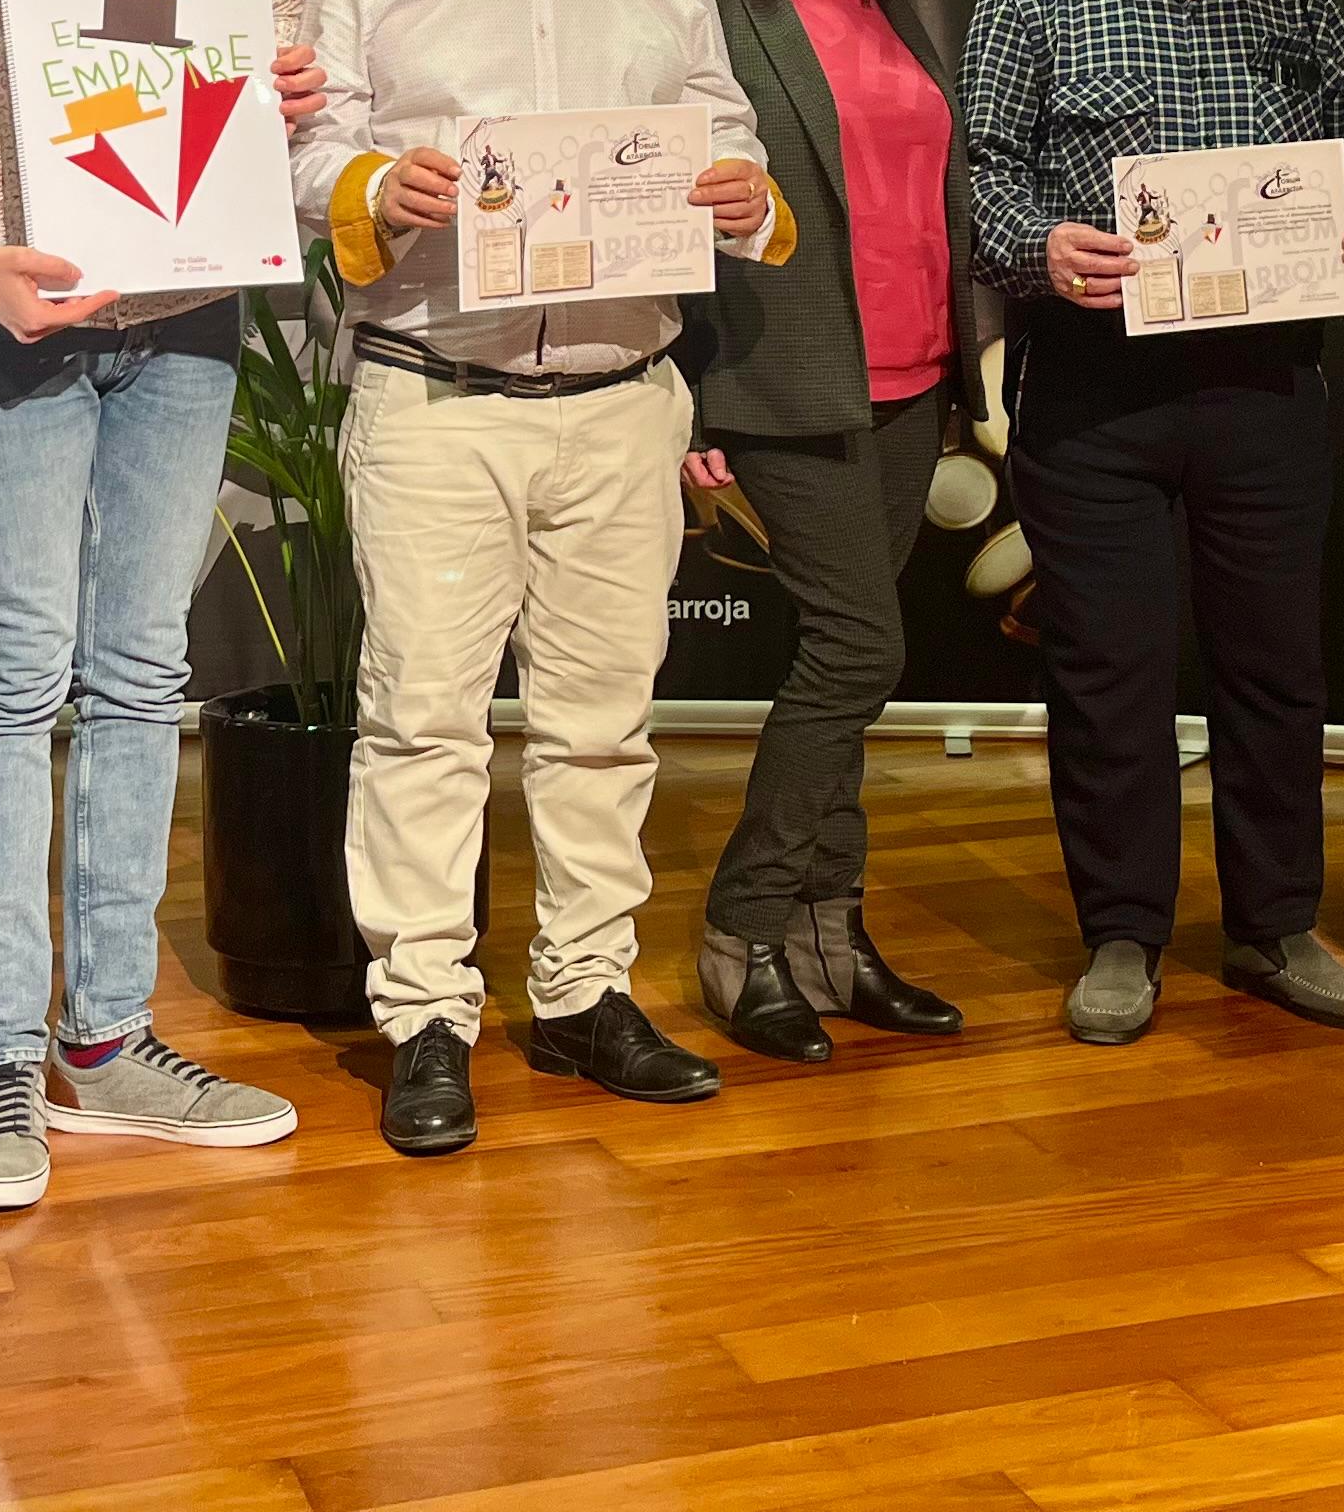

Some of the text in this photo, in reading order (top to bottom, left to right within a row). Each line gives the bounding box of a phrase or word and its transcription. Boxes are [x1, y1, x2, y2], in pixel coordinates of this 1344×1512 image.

[51, 19, 94, 49] EL
[42, 34, 254, 99] EMPASTRE
[667, 594, 750, 626] arroja
